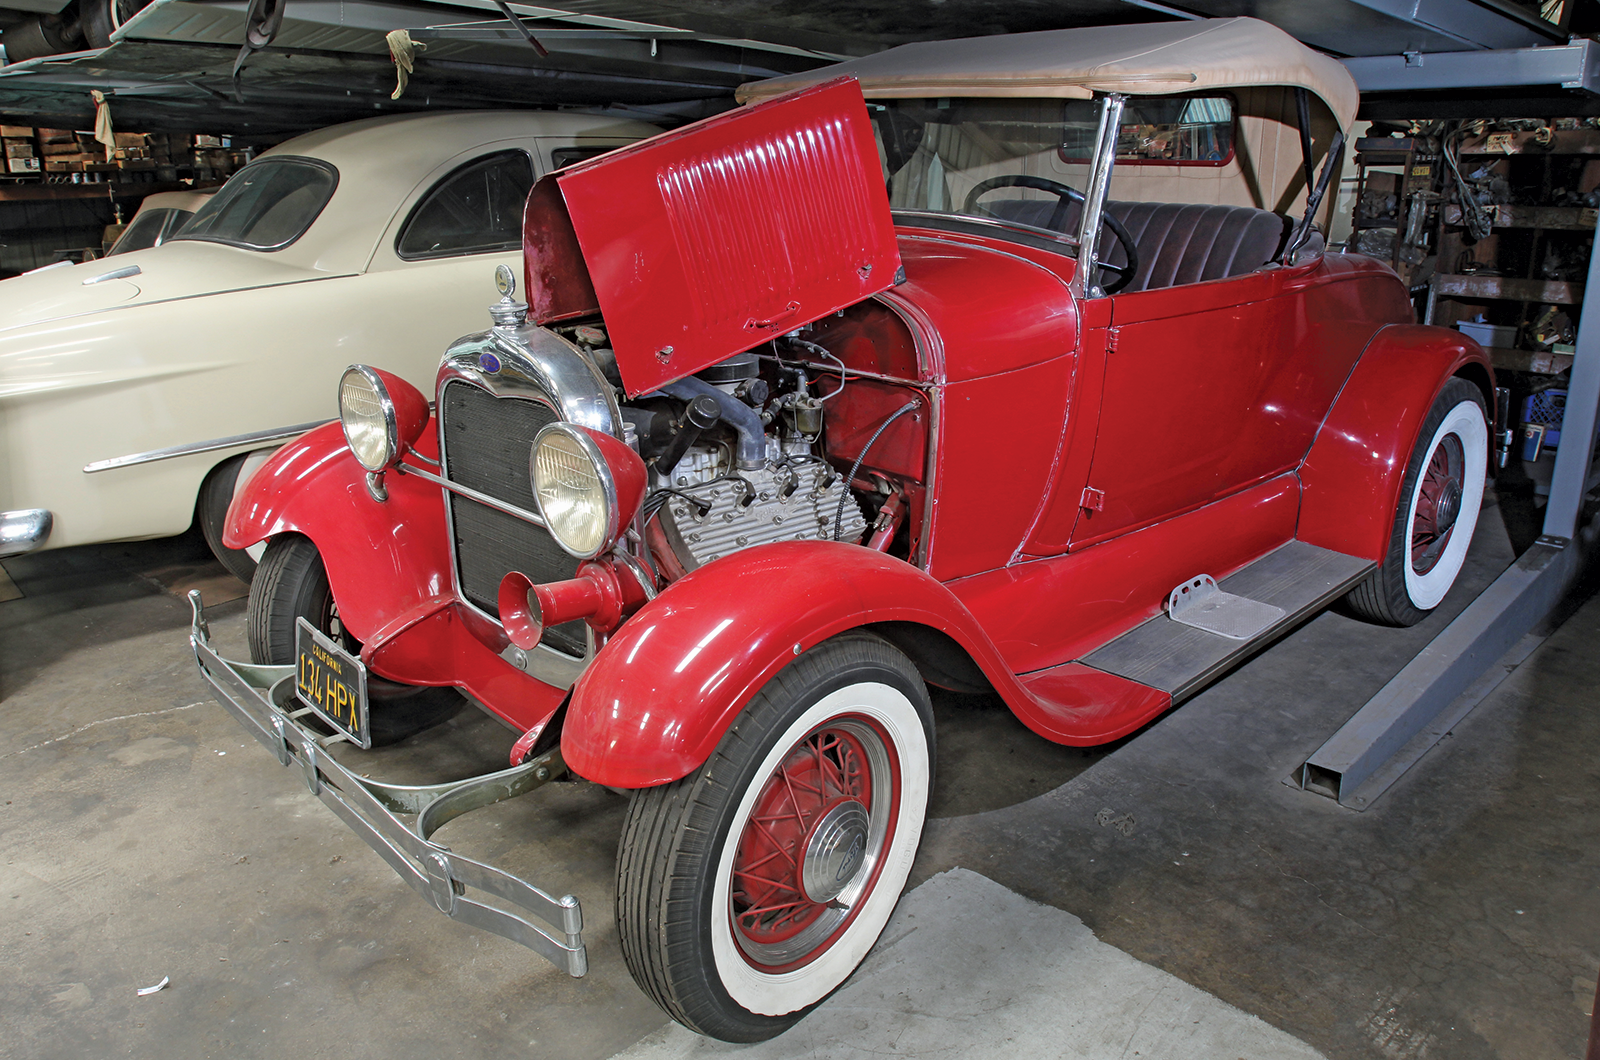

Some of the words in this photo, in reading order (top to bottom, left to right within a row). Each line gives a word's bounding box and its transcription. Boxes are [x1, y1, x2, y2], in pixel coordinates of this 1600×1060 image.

[312, 644, 342, 675] CALIFORNIA
[299, 653, 322, 704] 134
[325, 673, 358, 732] HPX
[894, 825, 919, 880] VOGUE
